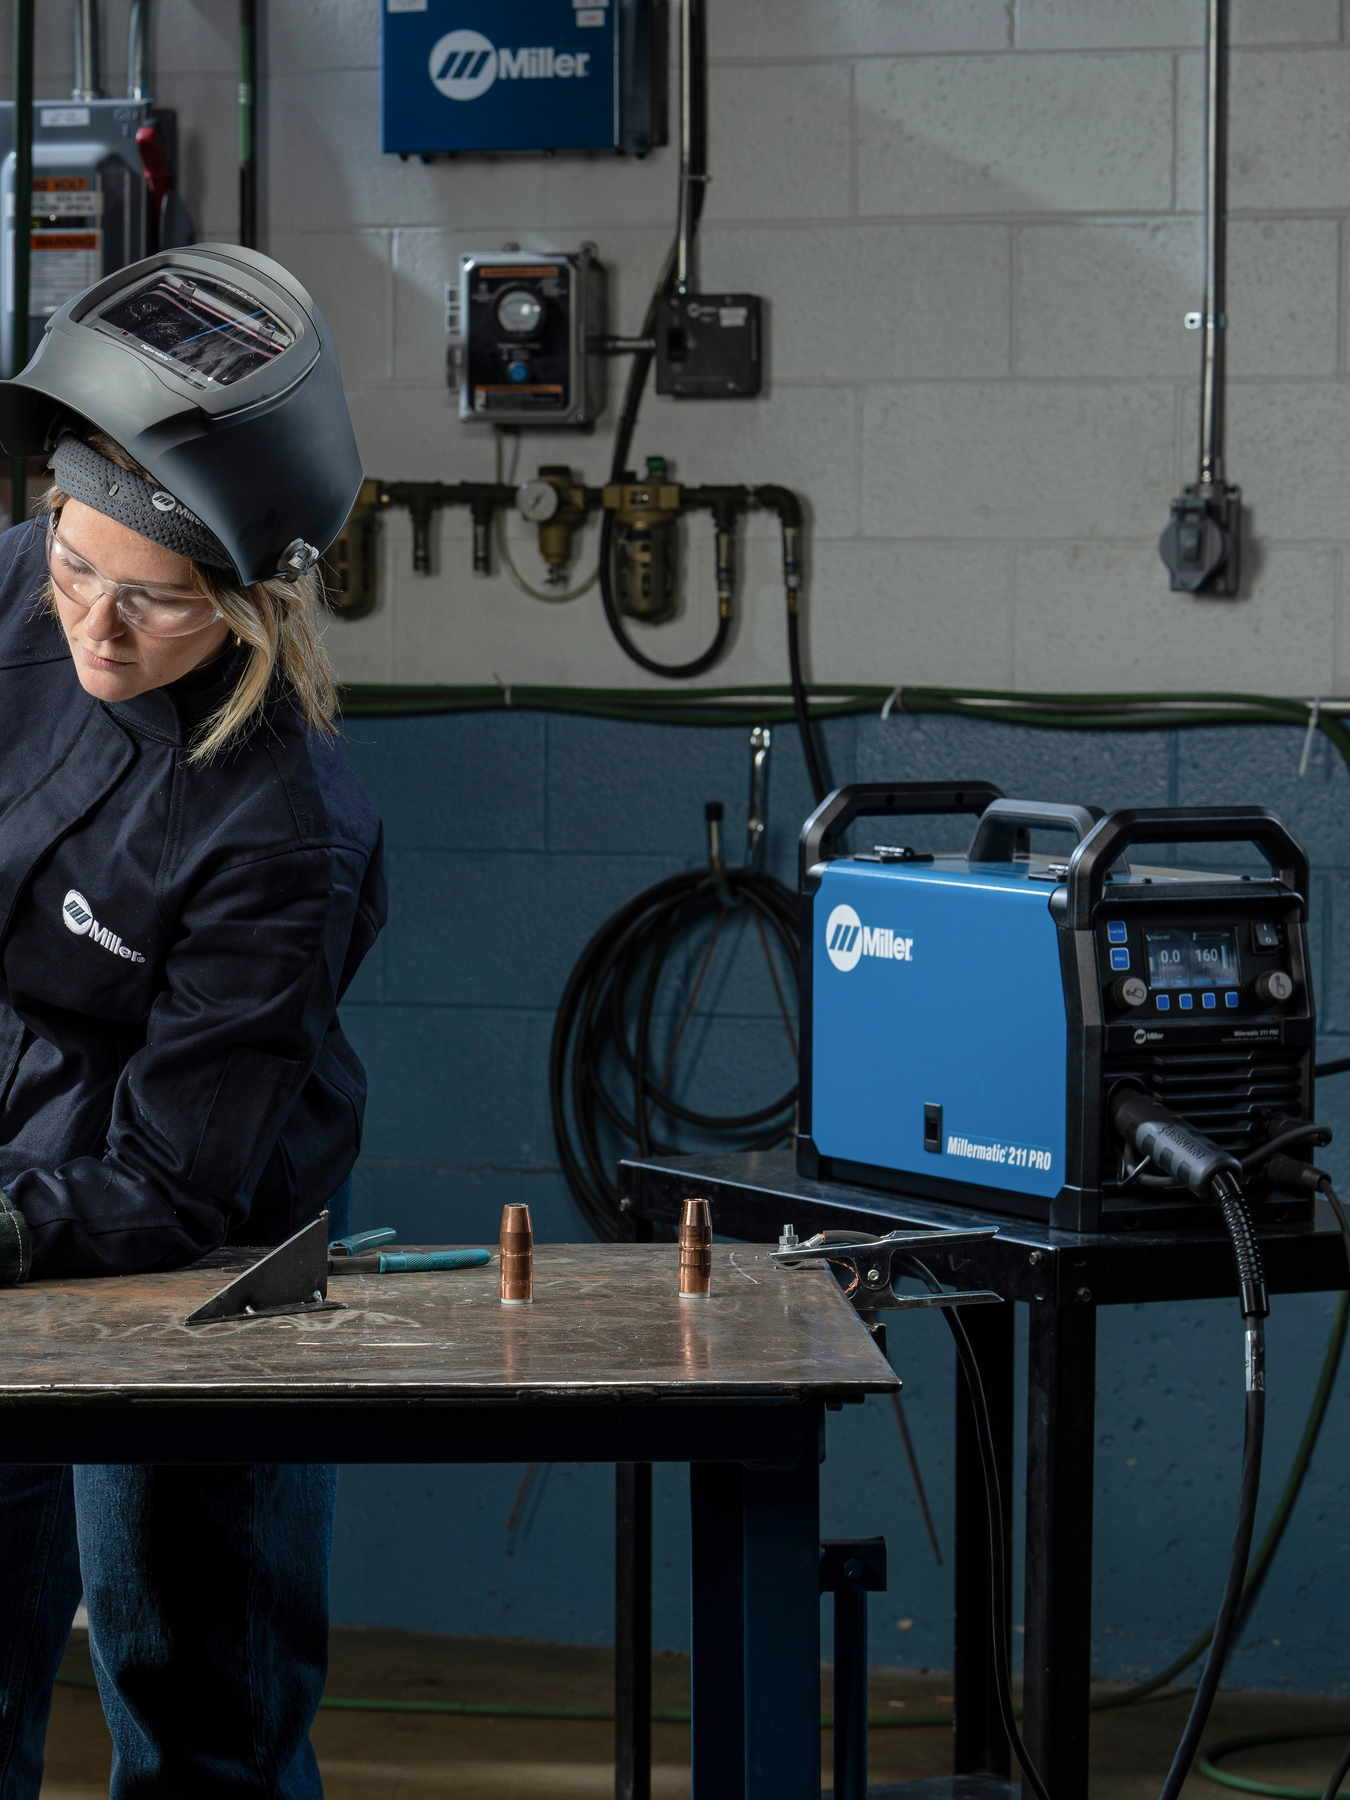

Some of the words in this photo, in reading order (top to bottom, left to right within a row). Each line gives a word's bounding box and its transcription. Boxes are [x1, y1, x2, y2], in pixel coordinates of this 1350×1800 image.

[498, 47, 590, 79] Miller
[36, 236, 96, 248] WARNING
[175, 503, 206, 528] Mille
[89, 919, 142, 962] Miller
[862, 925, 914, 962] Miller
[1160, 949, 1181, 964] 0.0
[1195, 948, 1219, 962] 160
[1146, 1031, 1164, 1040] Miller
[946, 1136, 1006, 1164] Millermatic
[1007, 1146, 1028, 1167] 211
[1028, 1149, 1052, 1171] PRO
[1165, 1128, 1206, 1160] BERNARD
